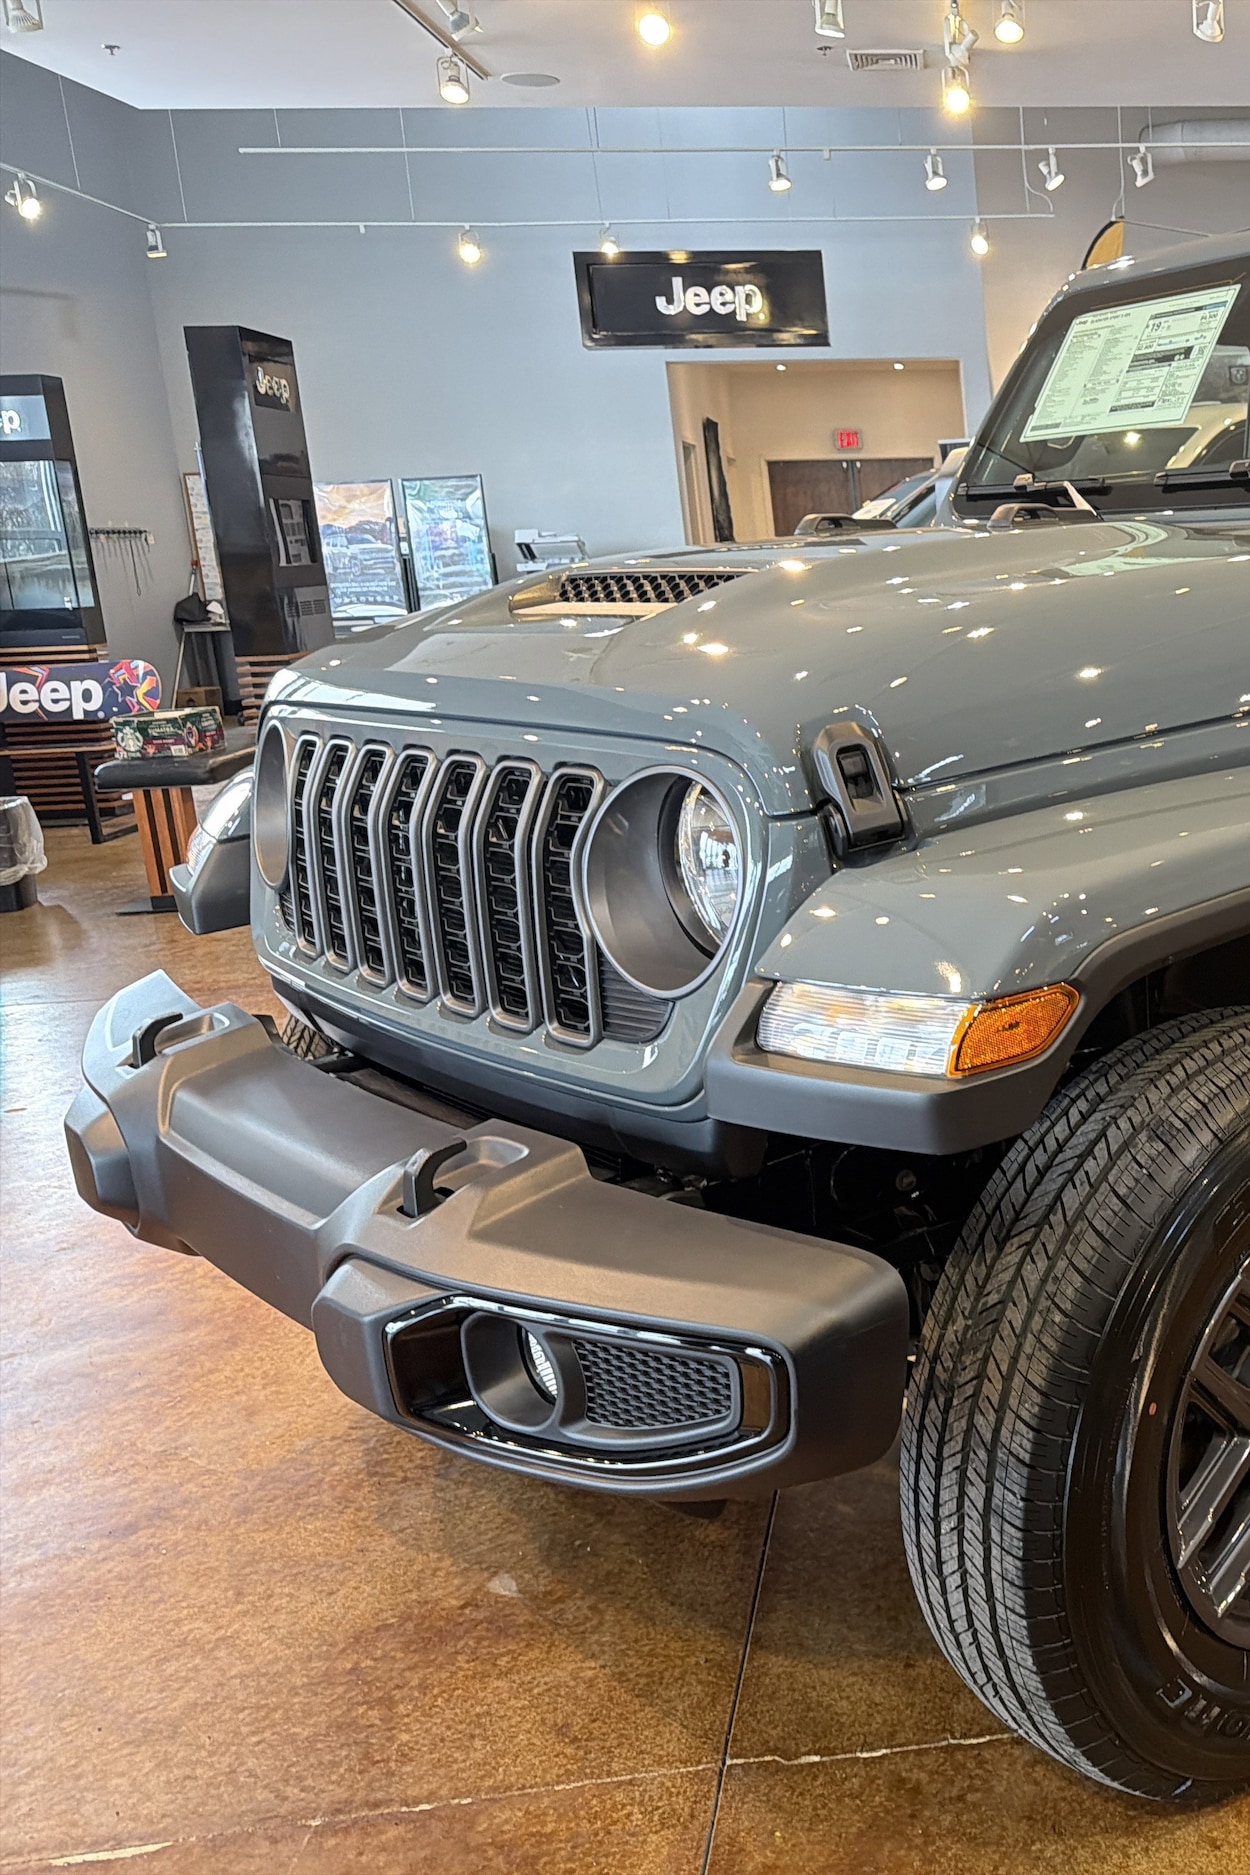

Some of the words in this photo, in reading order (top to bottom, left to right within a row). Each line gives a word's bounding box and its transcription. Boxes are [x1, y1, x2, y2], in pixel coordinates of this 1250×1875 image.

[655, 276, 763, 321] Jeep
[1150, 321, 1162, 332] 19
[255, 366, 290, 404] Jeep
[838, 431, 859, 448] EXIT
